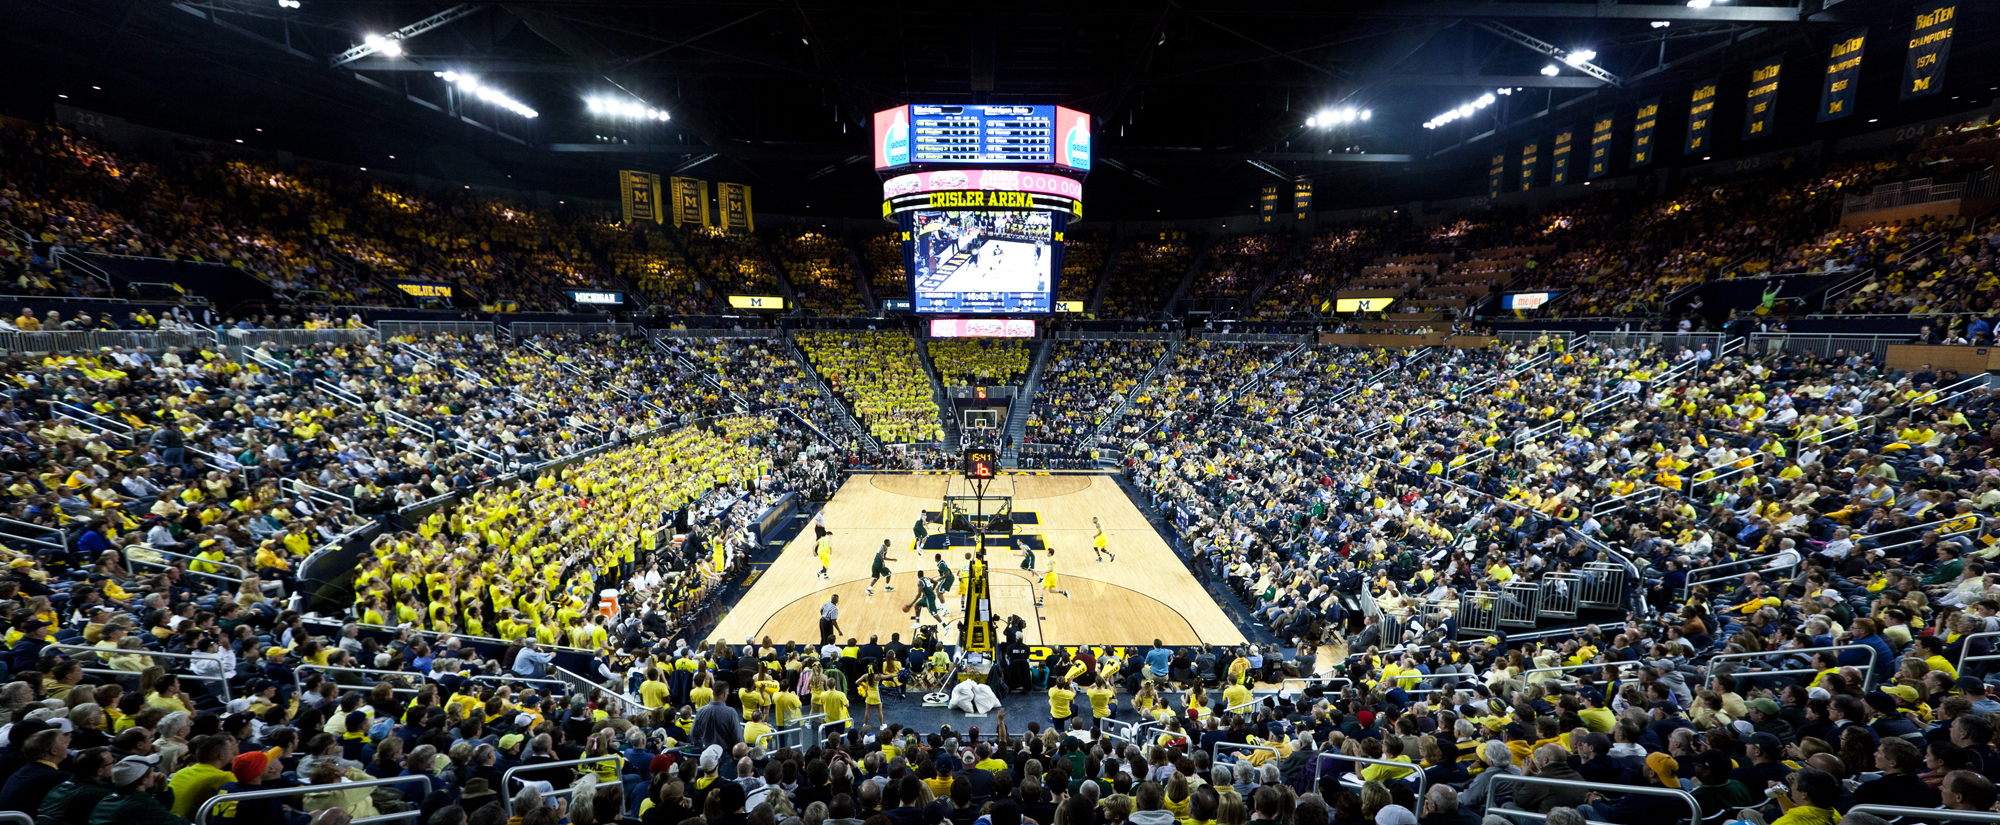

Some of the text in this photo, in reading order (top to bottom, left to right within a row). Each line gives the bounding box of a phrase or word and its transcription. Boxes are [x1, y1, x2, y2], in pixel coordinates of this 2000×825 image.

[1909, 27, 1953, 49] CHAMPIONS
[1827, 56, 1862, 74] CHAMPIONS
[1916, 52, 1937, 69] 1974
[1747, 81, 1778, 98] CHAMPIONS
[1912, 76, 1931, 92] M
[1829, 100, 1843, 114] M
[1750, 121, 1763, 134] M
[1896, 124, 1926, 141] 204
[891, 140, 906, 149] GOOD
[1072, 143, 1087, 152] GOOD
[1690, 137, 1702, 149] M
[891, 154, 906, 162] FOOD
[1072, 157, 1087, 165] FOOD
[1635, 152, 1645, 163] M
[1593, 163, 1602, 173] M
[1736, 157, 1760, 171] 203
[634, 190, 648, 202] M
[684, 196, 697, 207] M
[930, 191, 1034, 207] CRISLER ARENA
[730, 201, 742, 212] M
[902, 231, 910, 241] M
[1055, 232, 1064, 241] M
[575, 292, 616, 302] MICHIGAN
[750, 298, 762, 307] M
[1518, 295, 1542, 307] meijer
[1359, 300, 1370, 309] M
[972, 453, 991, 461] 15:41
[977, 463, 988, 476] 16
